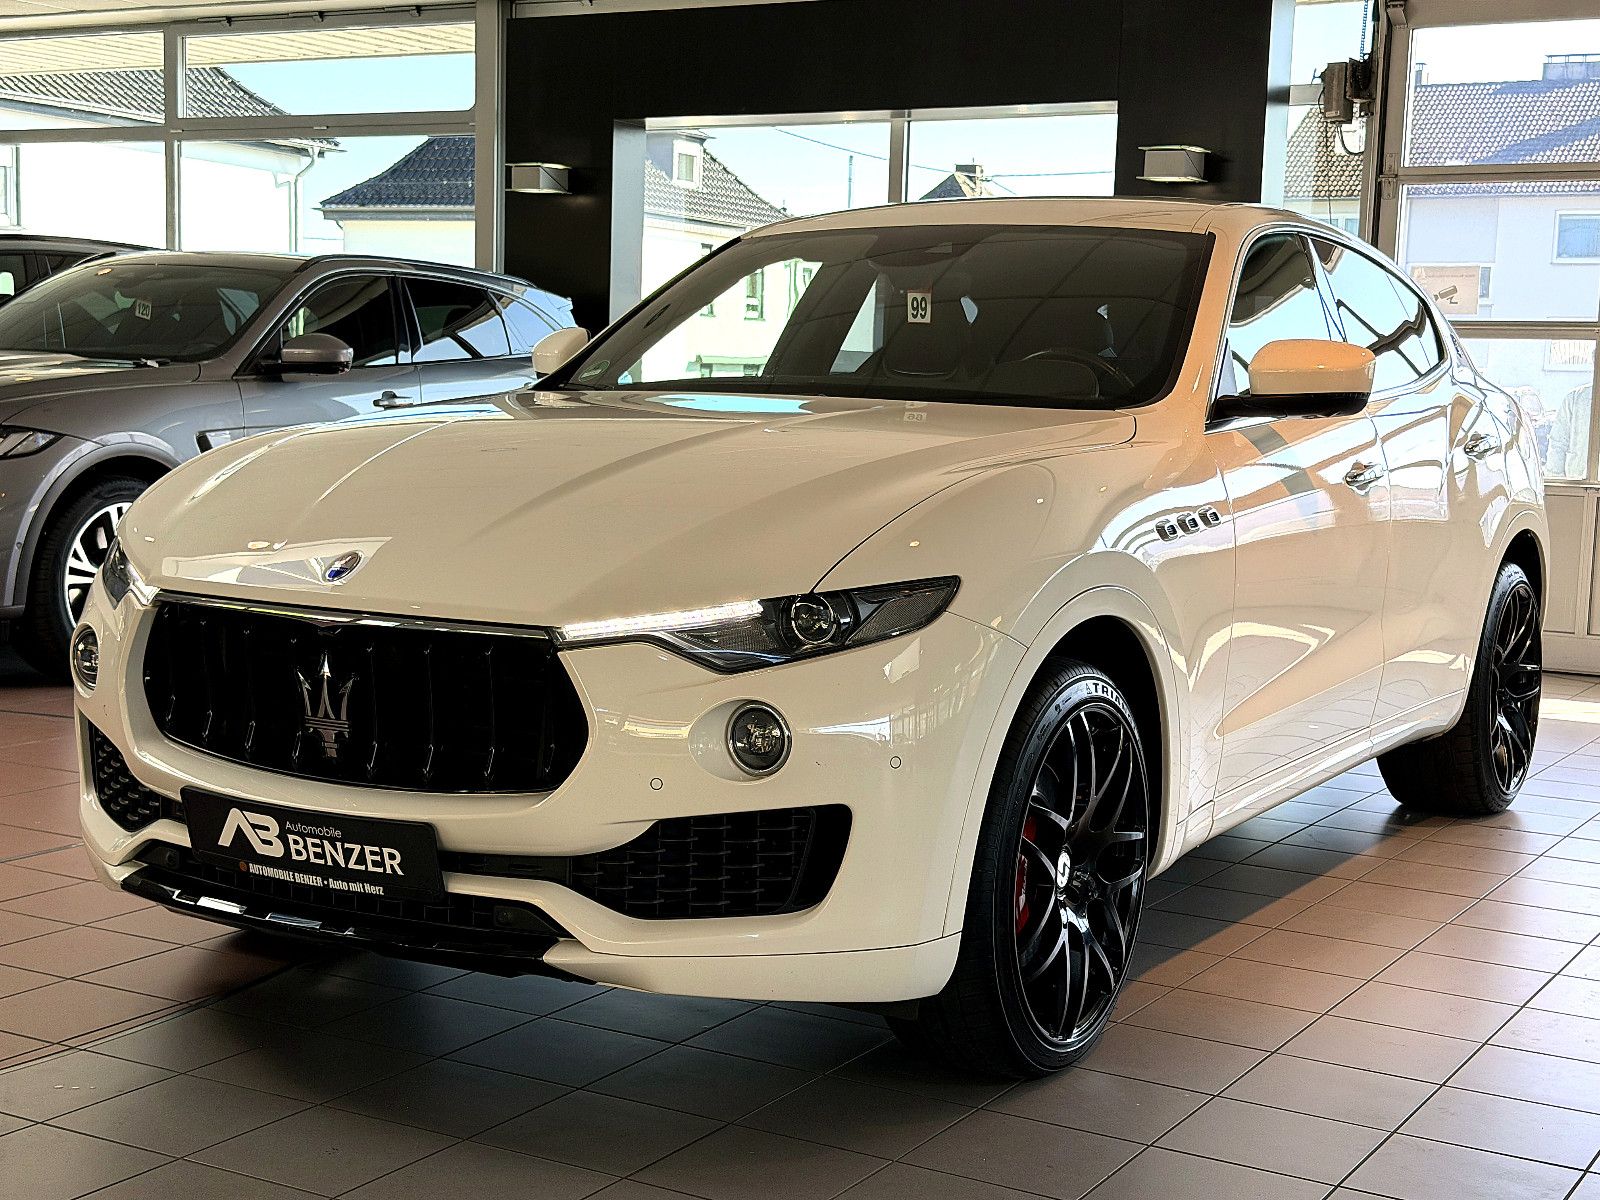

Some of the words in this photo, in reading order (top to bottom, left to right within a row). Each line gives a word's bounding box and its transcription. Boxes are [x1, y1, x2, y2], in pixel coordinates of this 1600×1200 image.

[137, 302, 151, 318] 120
[910, 296, 928, 320] 99
[217, 807, 285, 858] AB
[285, 821, 342, 838] Automobile
[286, 834, 405, 876] BENZER
[248, 862, 295, 882] AUTOMOBILE
[295, 872, 323, 888] BENZER
[328, 878, 349, 892] Auto
[349, 881, 364, 893] mit
[364, 882, 385, 896] Herz
